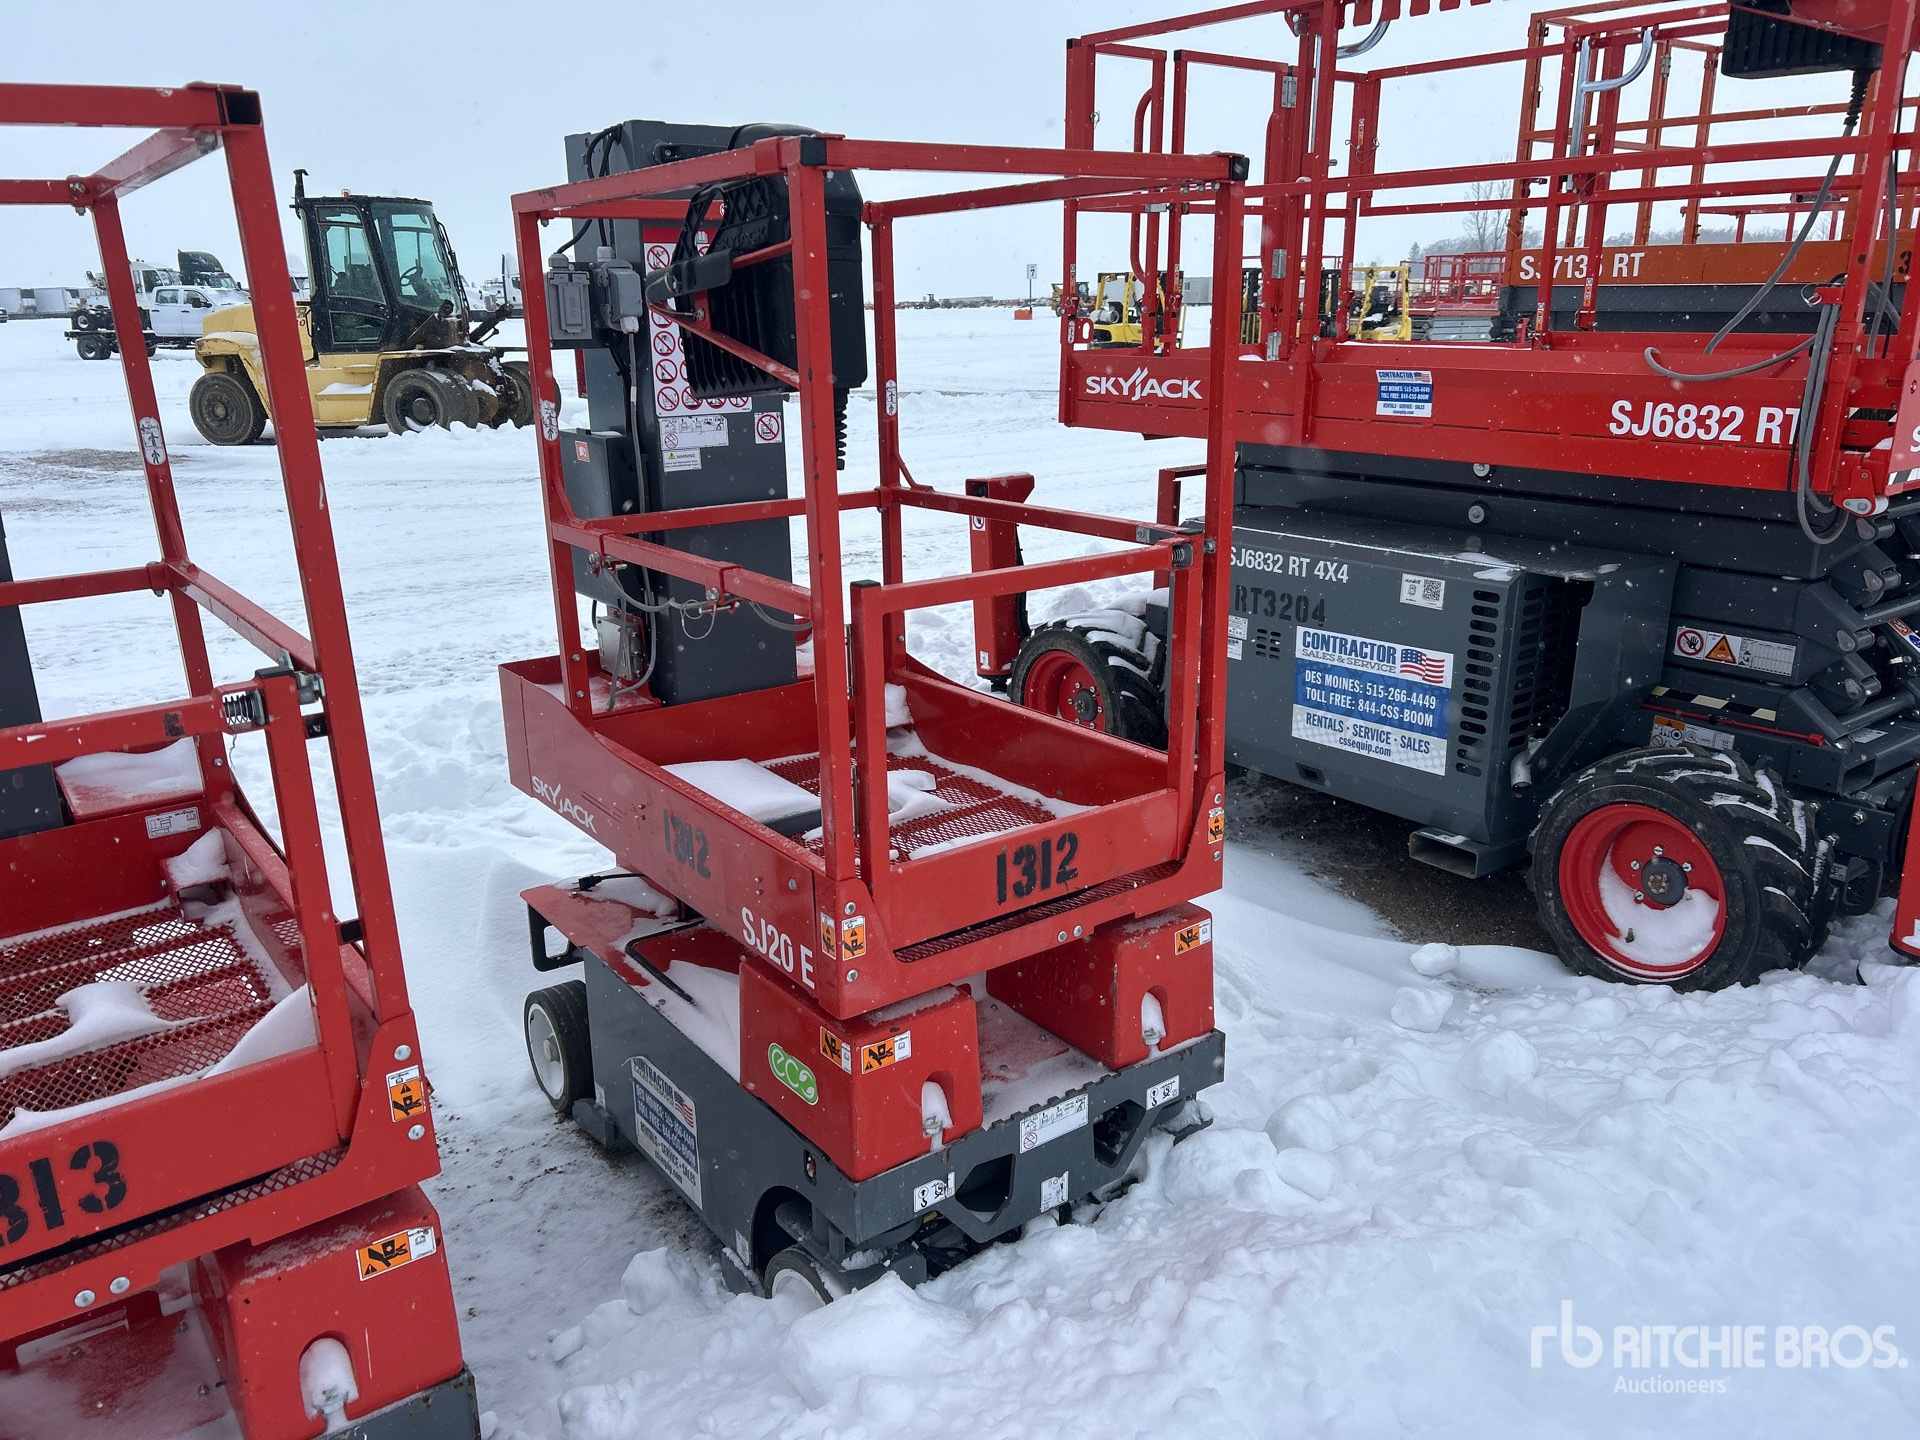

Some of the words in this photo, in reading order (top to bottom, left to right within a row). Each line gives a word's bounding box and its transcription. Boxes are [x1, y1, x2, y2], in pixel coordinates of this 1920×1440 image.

[1520, 254, 1603, 280] S713
[1612, 252, 1645, 278] RT
[1086, 366, 1203, 401] SKYJACK
[1609, 400, 1744, 442] SJ6832
[1755, 406, 1800, 445] RT
[1288, 555, 1311, 578] RT
[1314, 560, 1349, 584] 4X4
[1234, 584, 1326, 627] RT3204
[1302, 630, 1397, 665] CONTRACTOR
[1302, 648, 1336, 662] SALES
[1346, 658, 1397, 674] SERVICE
[1305, 669, 1322, 685] DES
[1324, 673, 1363, 694] MOINES:
[1366, 682, 1436, 709] 515-266-4449
[1305, 686, 1327, 704] TOLL
[1329, 692, 1355, 710] FREE:
[1358, 698, 1433, 728] 844-CSS-BOOM
[1306, 712, 1344, 733] RENTALS
[1352, 723, 1392, 745] SERVICE
[1400, 735, 1430, 754] SALES
[1338, 736, 1392, 757] cssequip.com
[531, 775, 598, 834] SKYJACK
[663, 808, 711, 879] 1312
[996, 832, 1078, 903] 1312
[741, 906, 794, 973] SJ20
[800, 944, 815, 990] E
